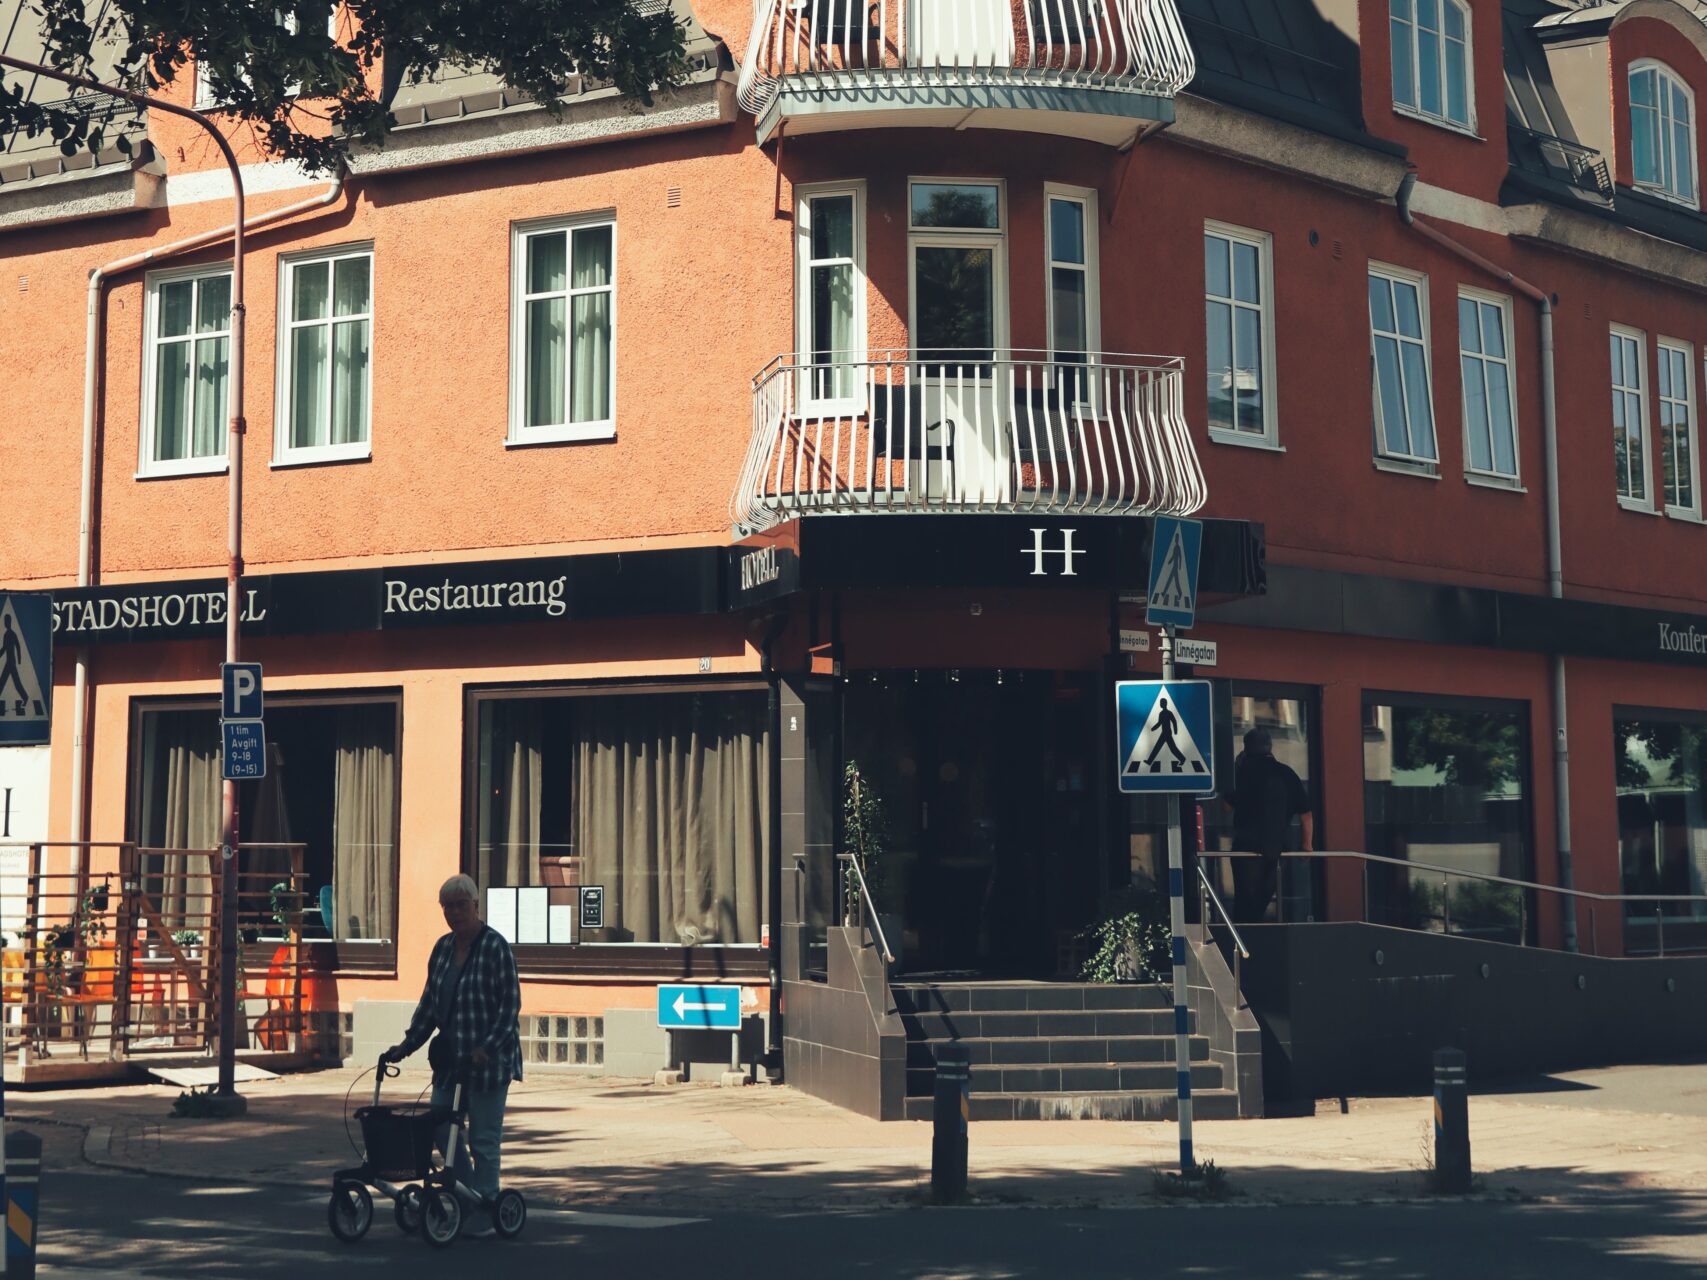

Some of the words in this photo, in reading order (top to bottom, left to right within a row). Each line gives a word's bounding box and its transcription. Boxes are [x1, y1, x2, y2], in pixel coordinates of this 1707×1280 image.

[1020, 528, 1087, 575] H
[384, 576, 567, 616] Restaurang
[1119, 634, 1149, 647] innégatan
[1657, 622, 1707, 654] Konfer
[1176, 641, 1215, 662] Linnégatan
[699, 657, 710, 671] 20
[233, 669, 256, 714] P
[236, 725, 249, 735] tim
[231, 738, 257, 751] Avgift
[231, 751, 251, 762] 9-18
[231, 763, 257, 776] (9-15)
